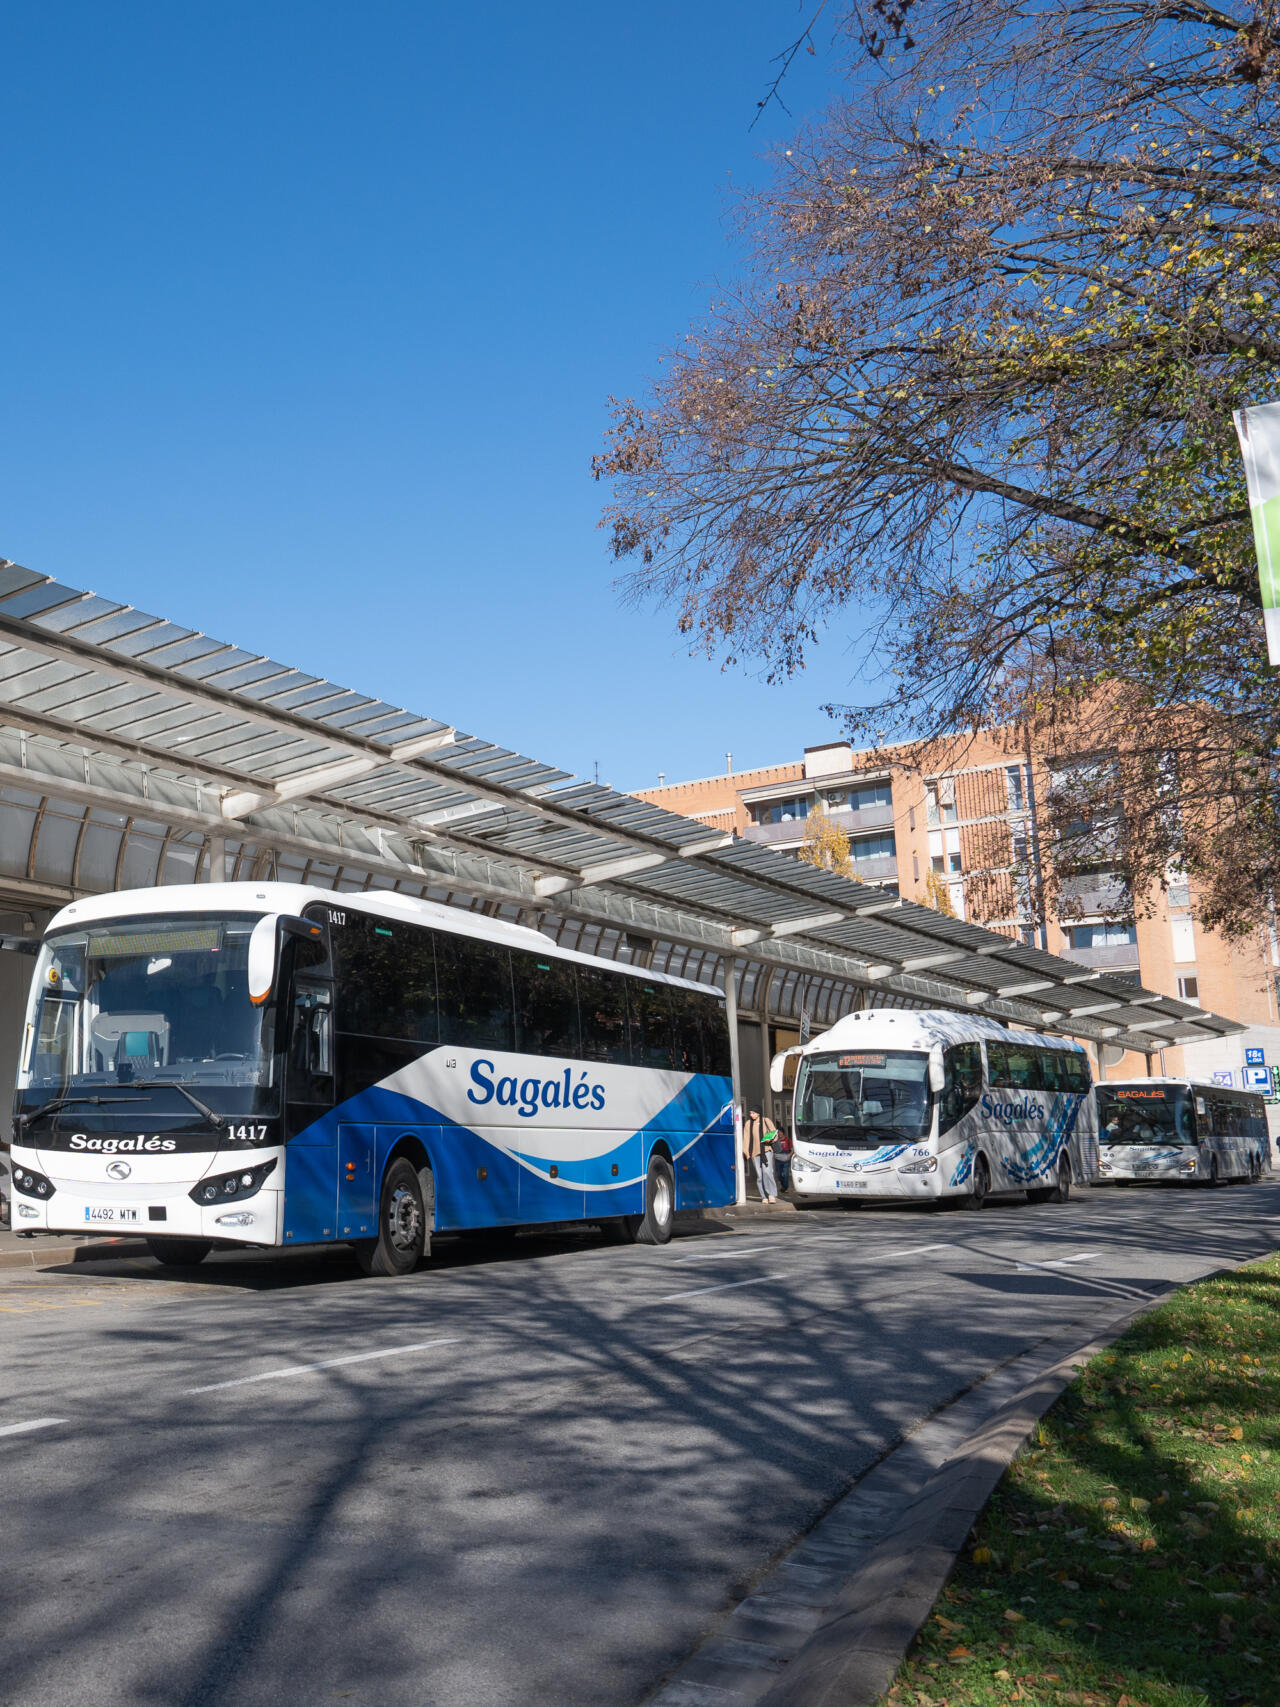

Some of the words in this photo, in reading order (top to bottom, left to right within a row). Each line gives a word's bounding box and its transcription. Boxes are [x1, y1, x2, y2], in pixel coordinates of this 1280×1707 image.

[328, 910, 346, 926] 1417
[467, 1059, 605, 1117] Sagalés
[981, 1094, 1045, 1125] Sagalés
[227, 1125, 268, 1140] 1417
[69, 1134, 176, 1153] Sagalés
[912, 1148, 930, 1157] 766
[91, 1207, 114, 1220] 4492
[120, 1208, 137, 1221] MTW
